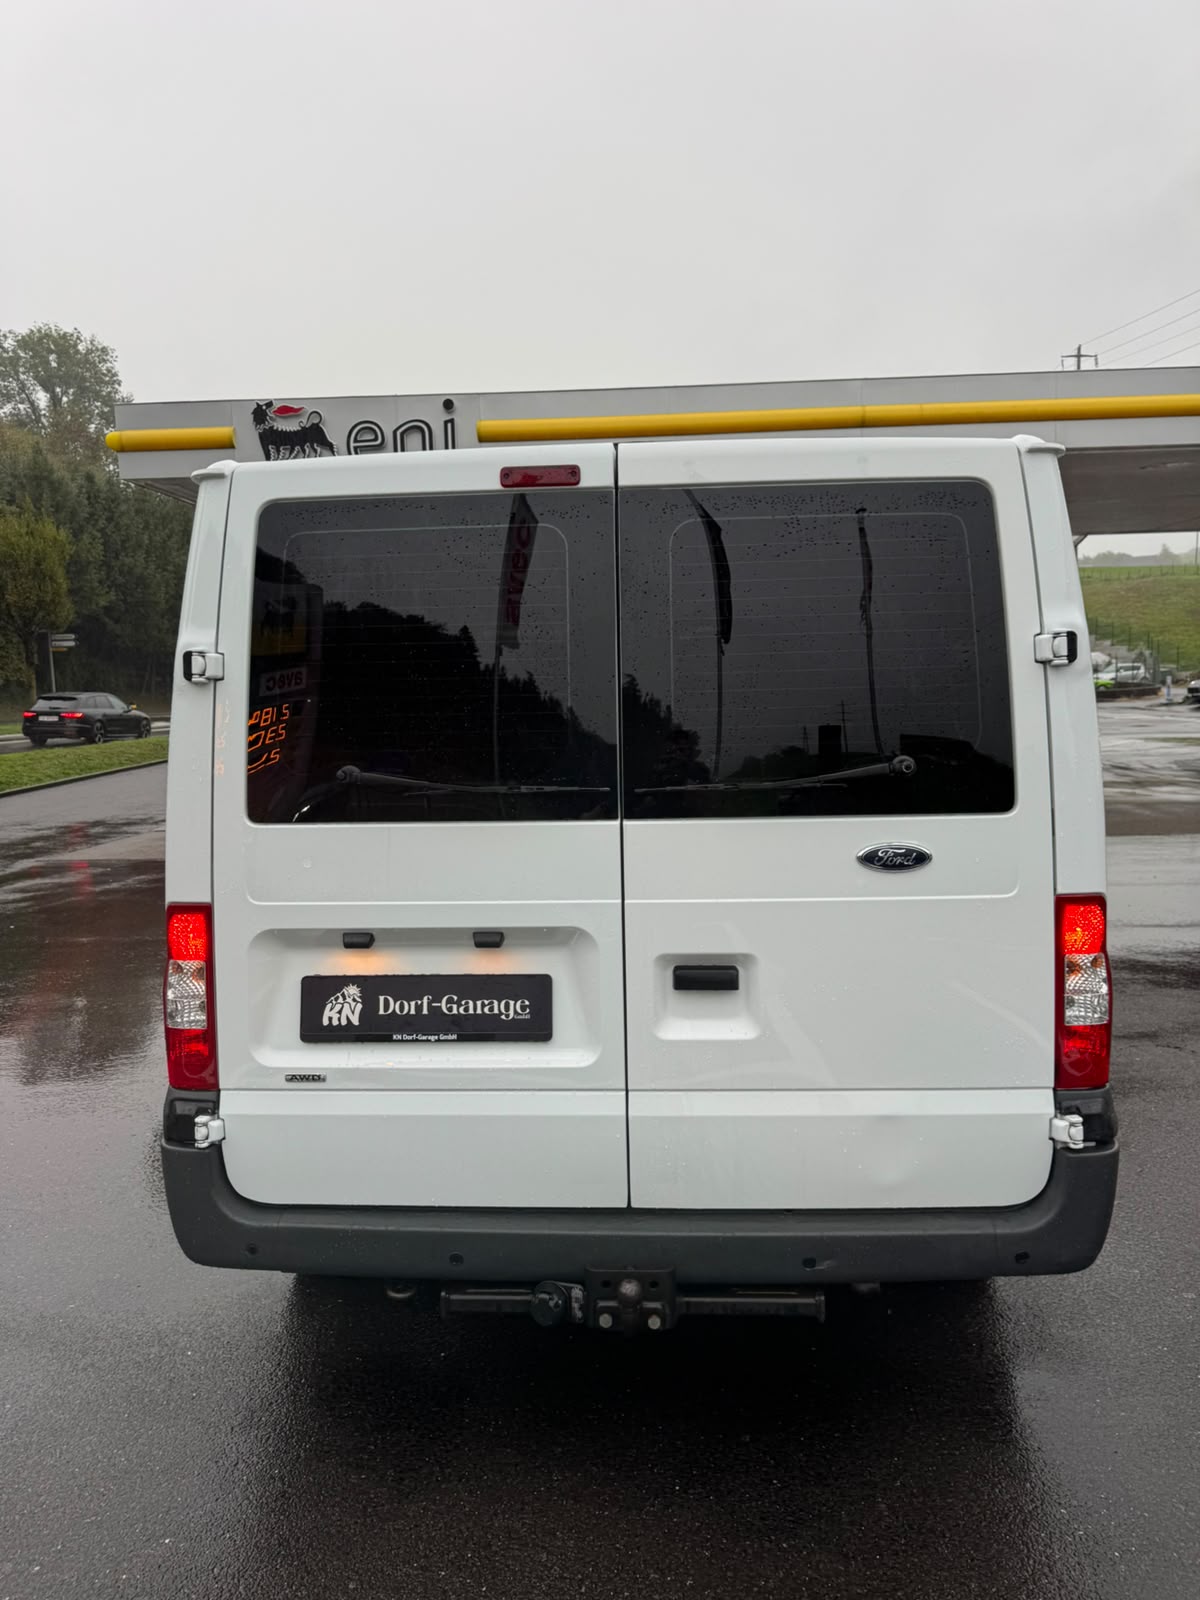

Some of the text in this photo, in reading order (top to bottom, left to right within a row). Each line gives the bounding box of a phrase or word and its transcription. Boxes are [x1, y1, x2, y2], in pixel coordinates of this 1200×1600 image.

[346, 398, 456, 455] eni
[874, 848, 917, 865] Ford
[322, 1001, 363, 1027] KN
[378, 994, 531, 1020] Dorf-Garage
[403, 1033, 438, 1042] Dorf-Garage
[288, 1074, 321, 1082] AWD
